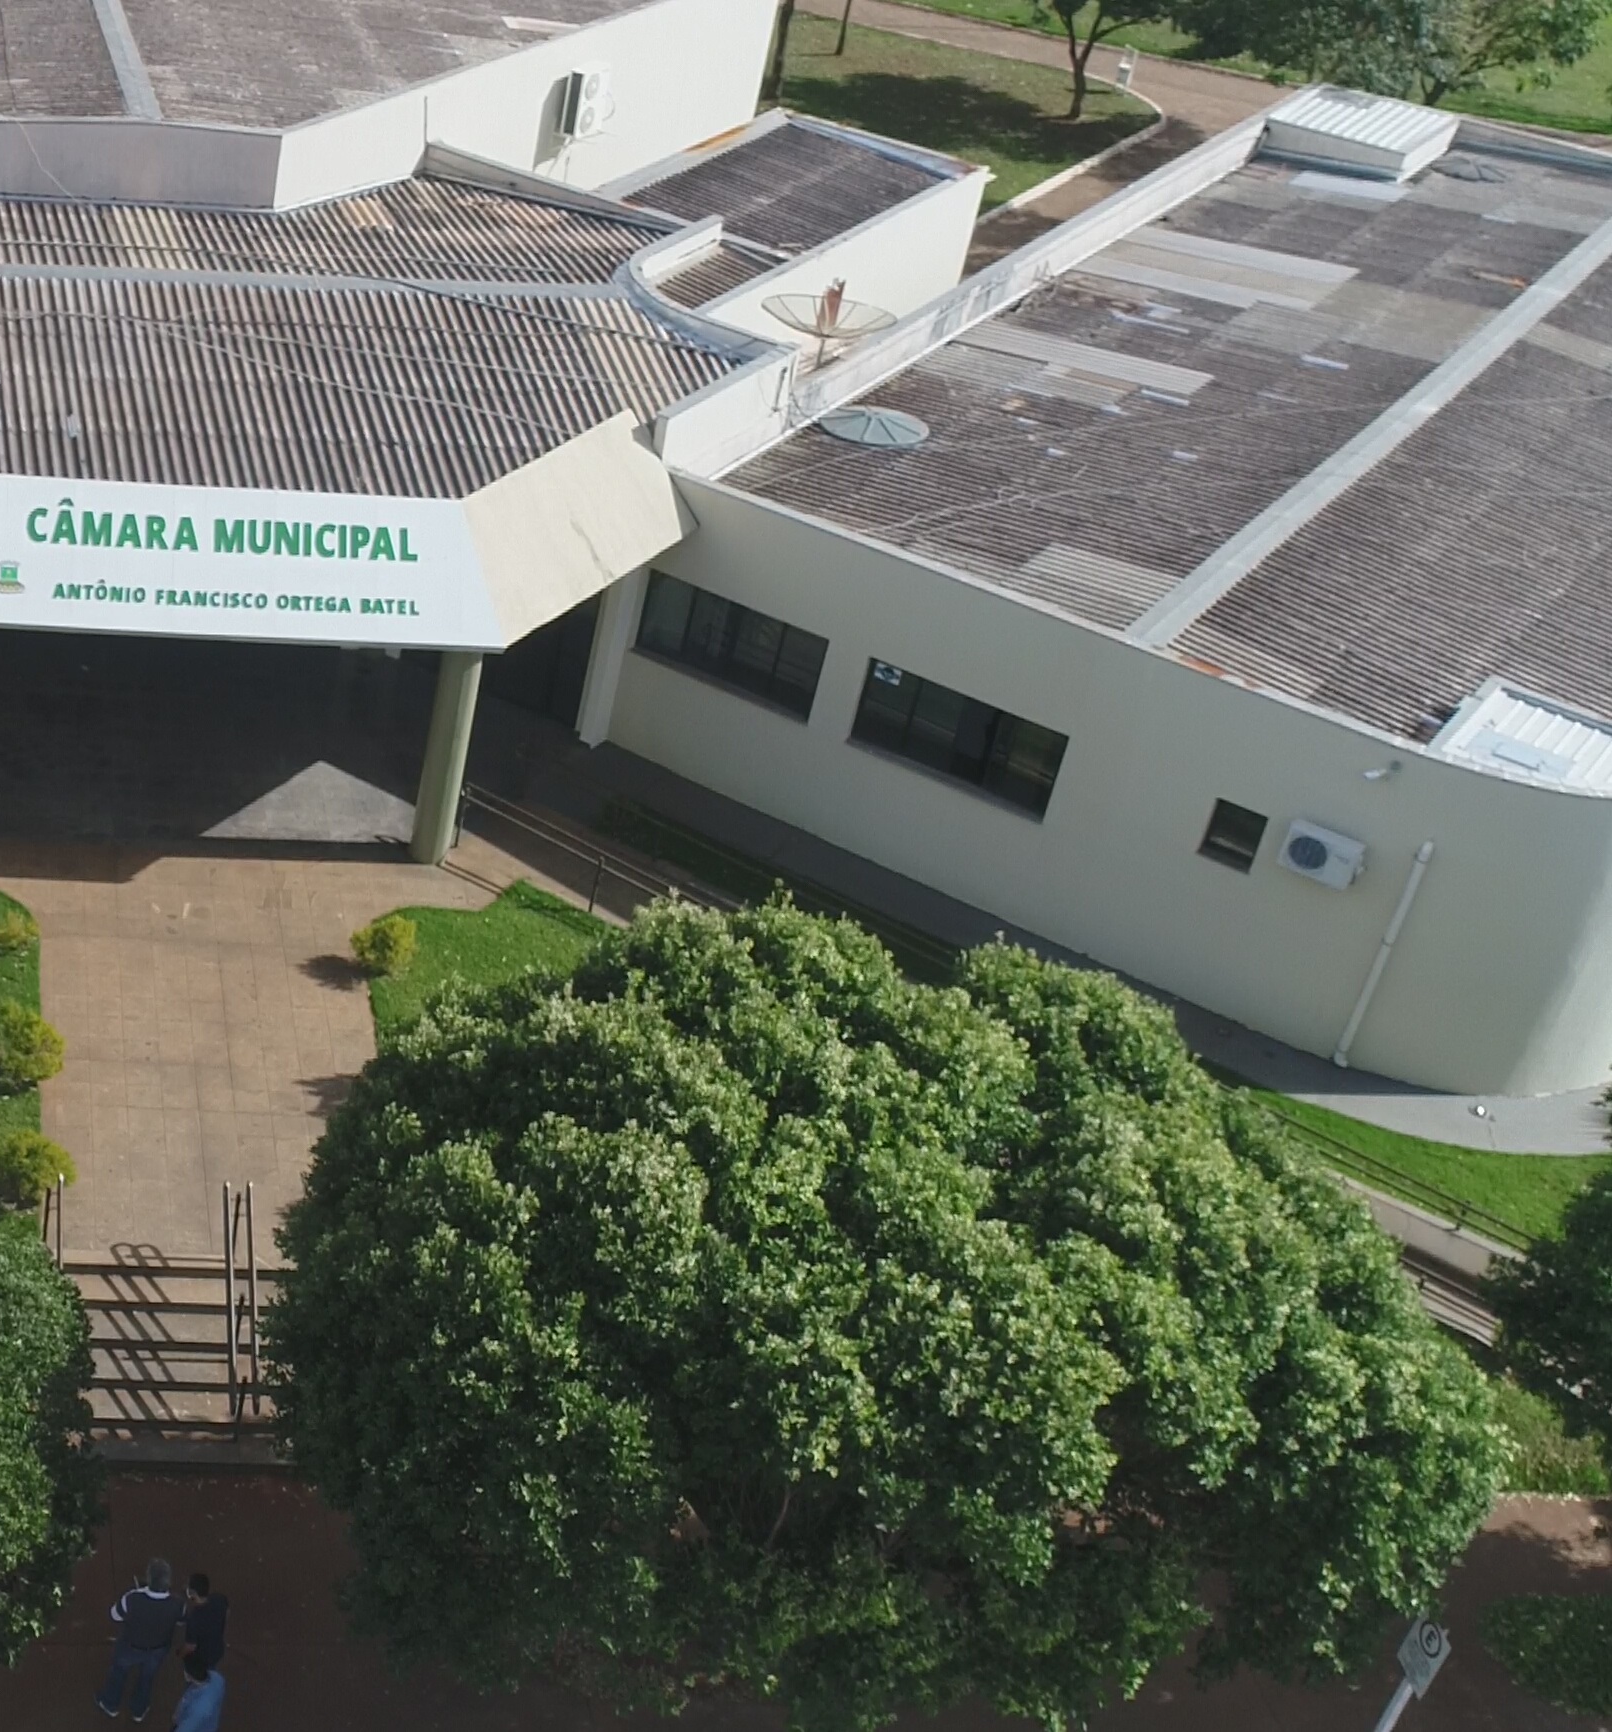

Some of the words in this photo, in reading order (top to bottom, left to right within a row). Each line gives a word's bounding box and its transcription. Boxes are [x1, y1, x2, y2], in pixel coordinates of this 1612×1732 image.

[25, 498, 200, 553] CÂMARA
[214, 517, 420, 563] MUNICIPAL
[52, 579, 146, 604] ANTÔNIO
[155, 588, 269, 610] FRANCISCO
[276, 593, 352, 614] ORTEGA
[360, 598, 420, 616] BATEL
